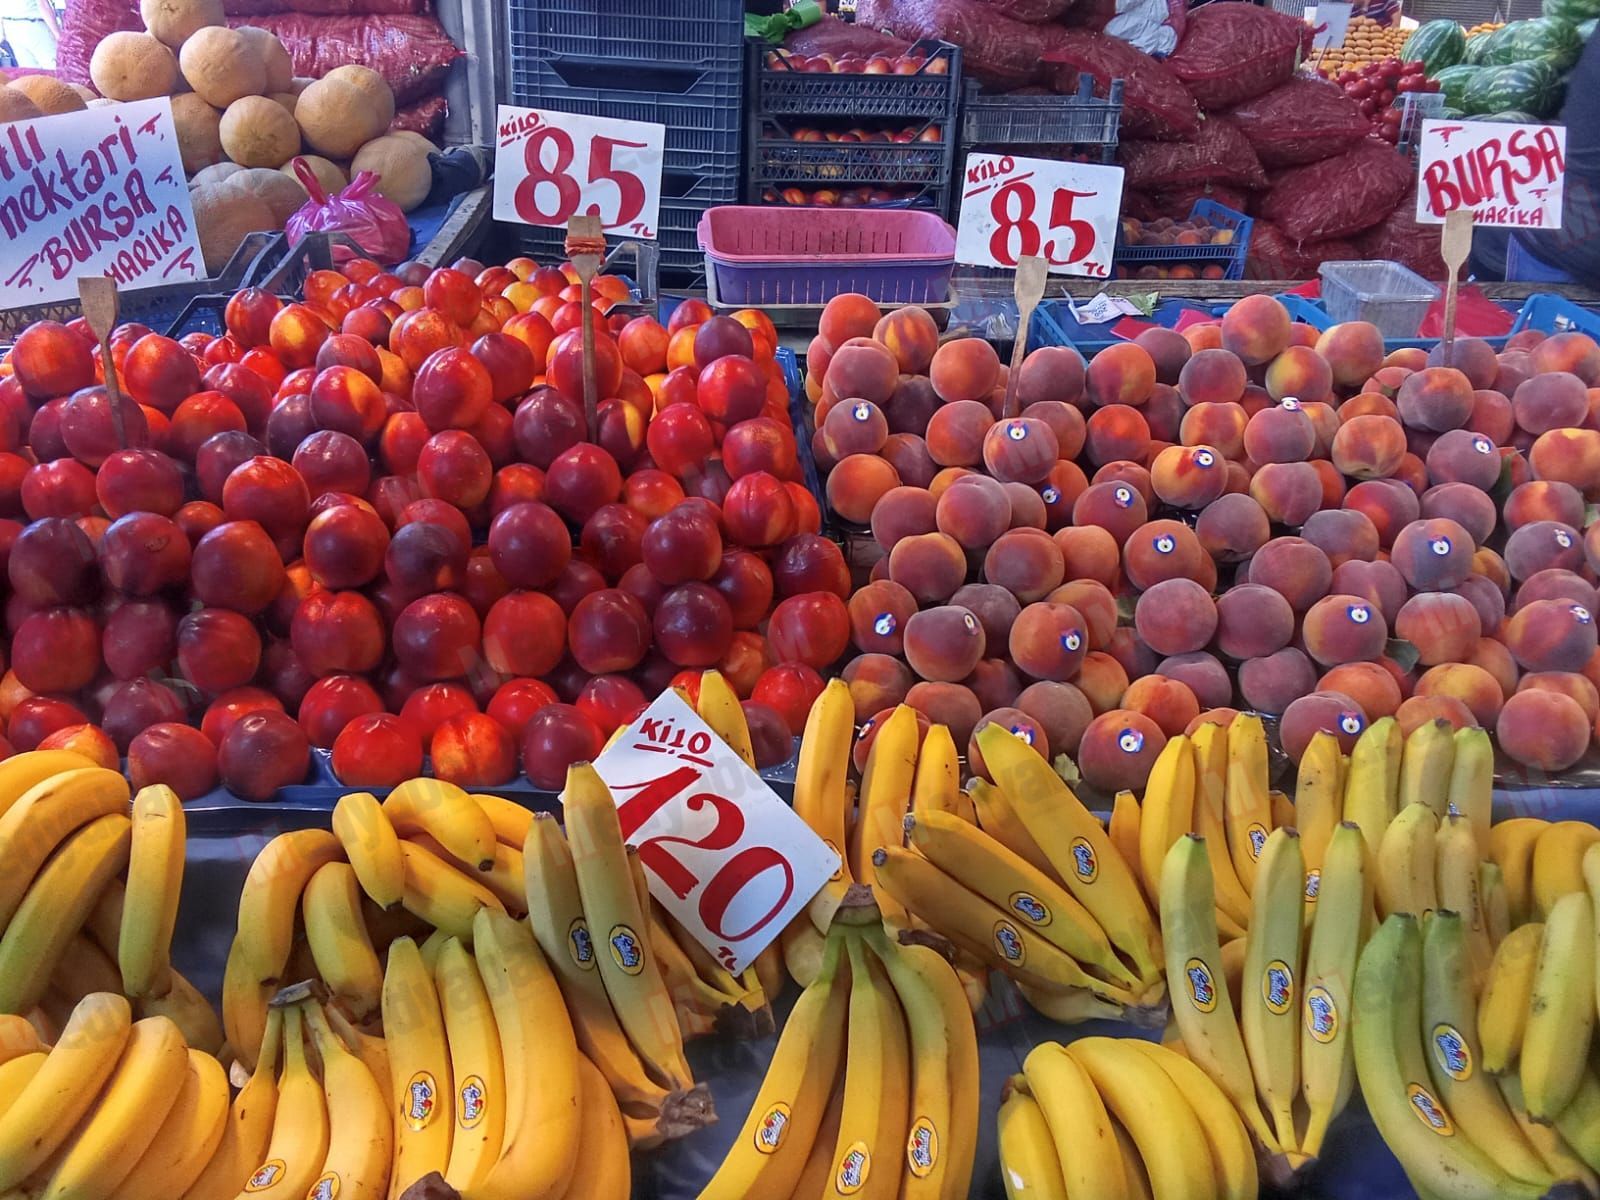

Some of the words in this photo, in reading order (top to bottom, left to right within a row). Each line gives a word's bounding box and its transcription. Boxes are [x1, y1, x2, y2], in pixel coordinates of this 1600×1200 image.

[1423, 127, 1566, 218] BURSA
[40, 168, 157, 280] BURSA
[630, 223, 655, 237] TL
[989, 182, 1097, 267] 85
[609, 765, 795, 942] 120
